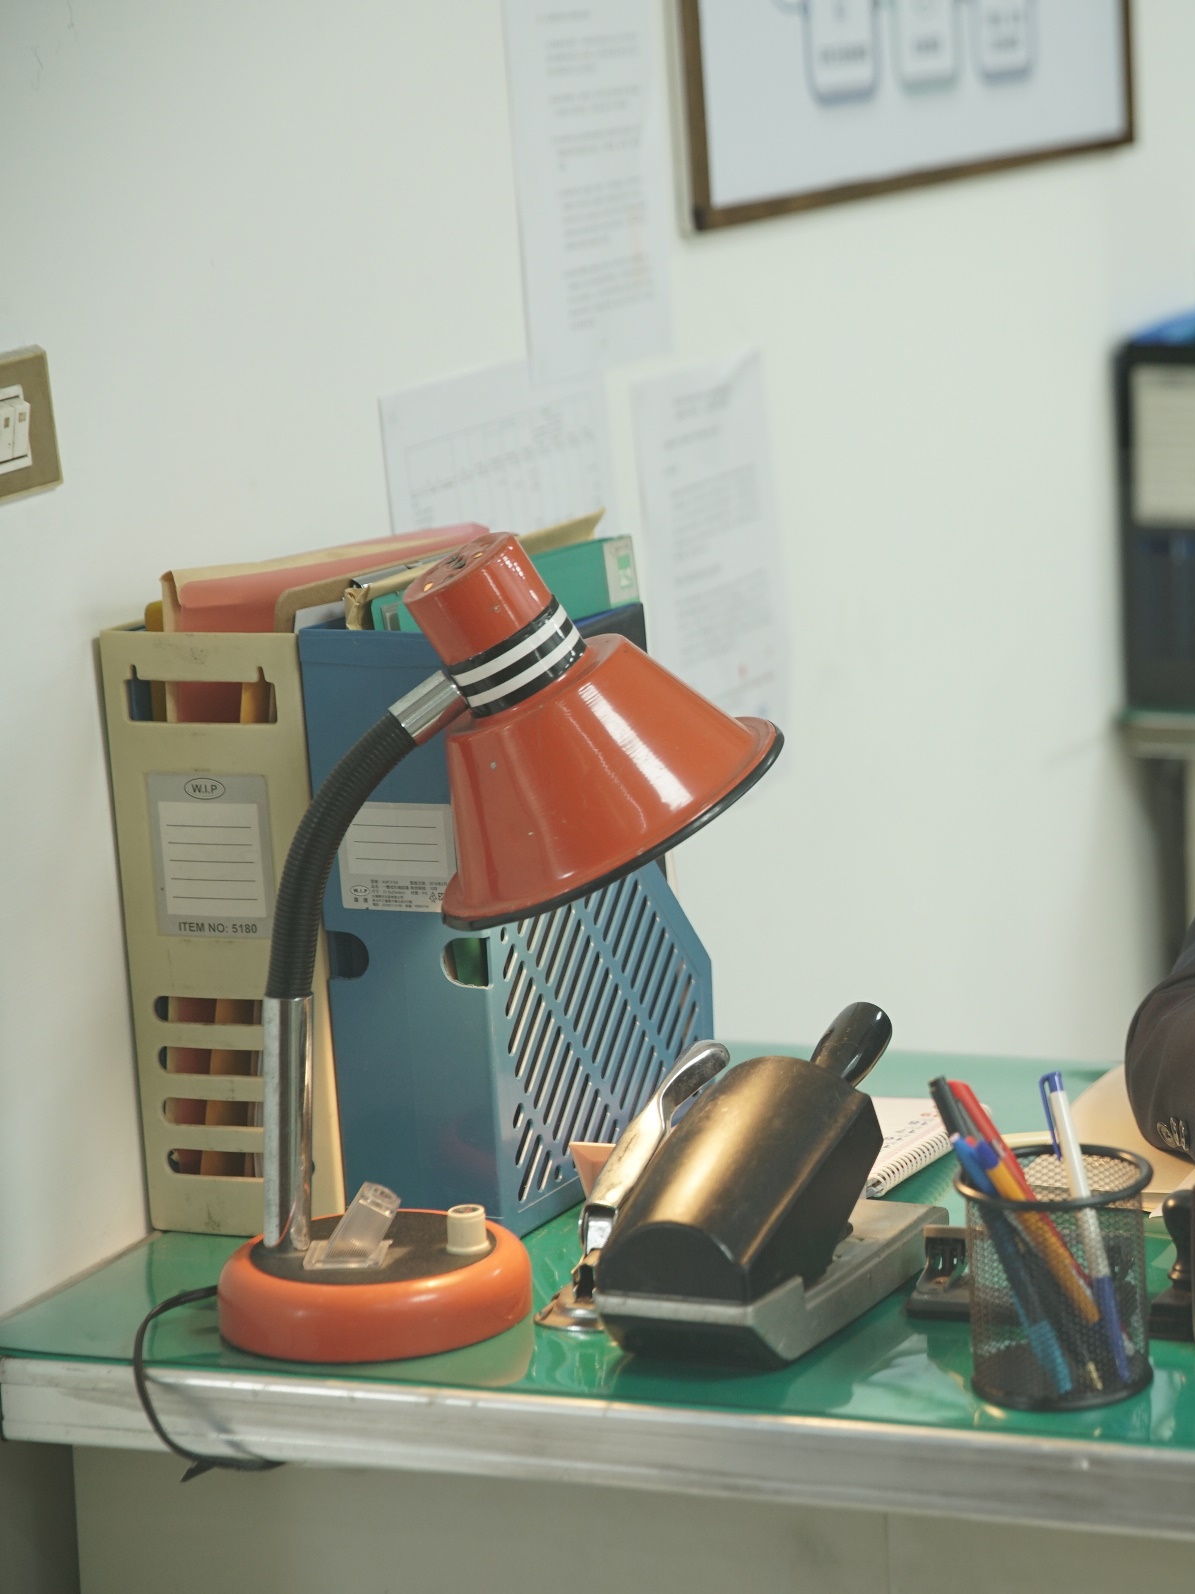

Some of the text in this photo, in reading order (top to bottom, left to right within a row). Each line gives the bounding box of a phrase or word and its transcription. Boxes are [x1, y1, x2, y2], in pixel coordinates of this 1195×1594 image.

[191, 784, 217, 794] W.I.P
[178, 922, 258, 934] ITEM NO: 5180
